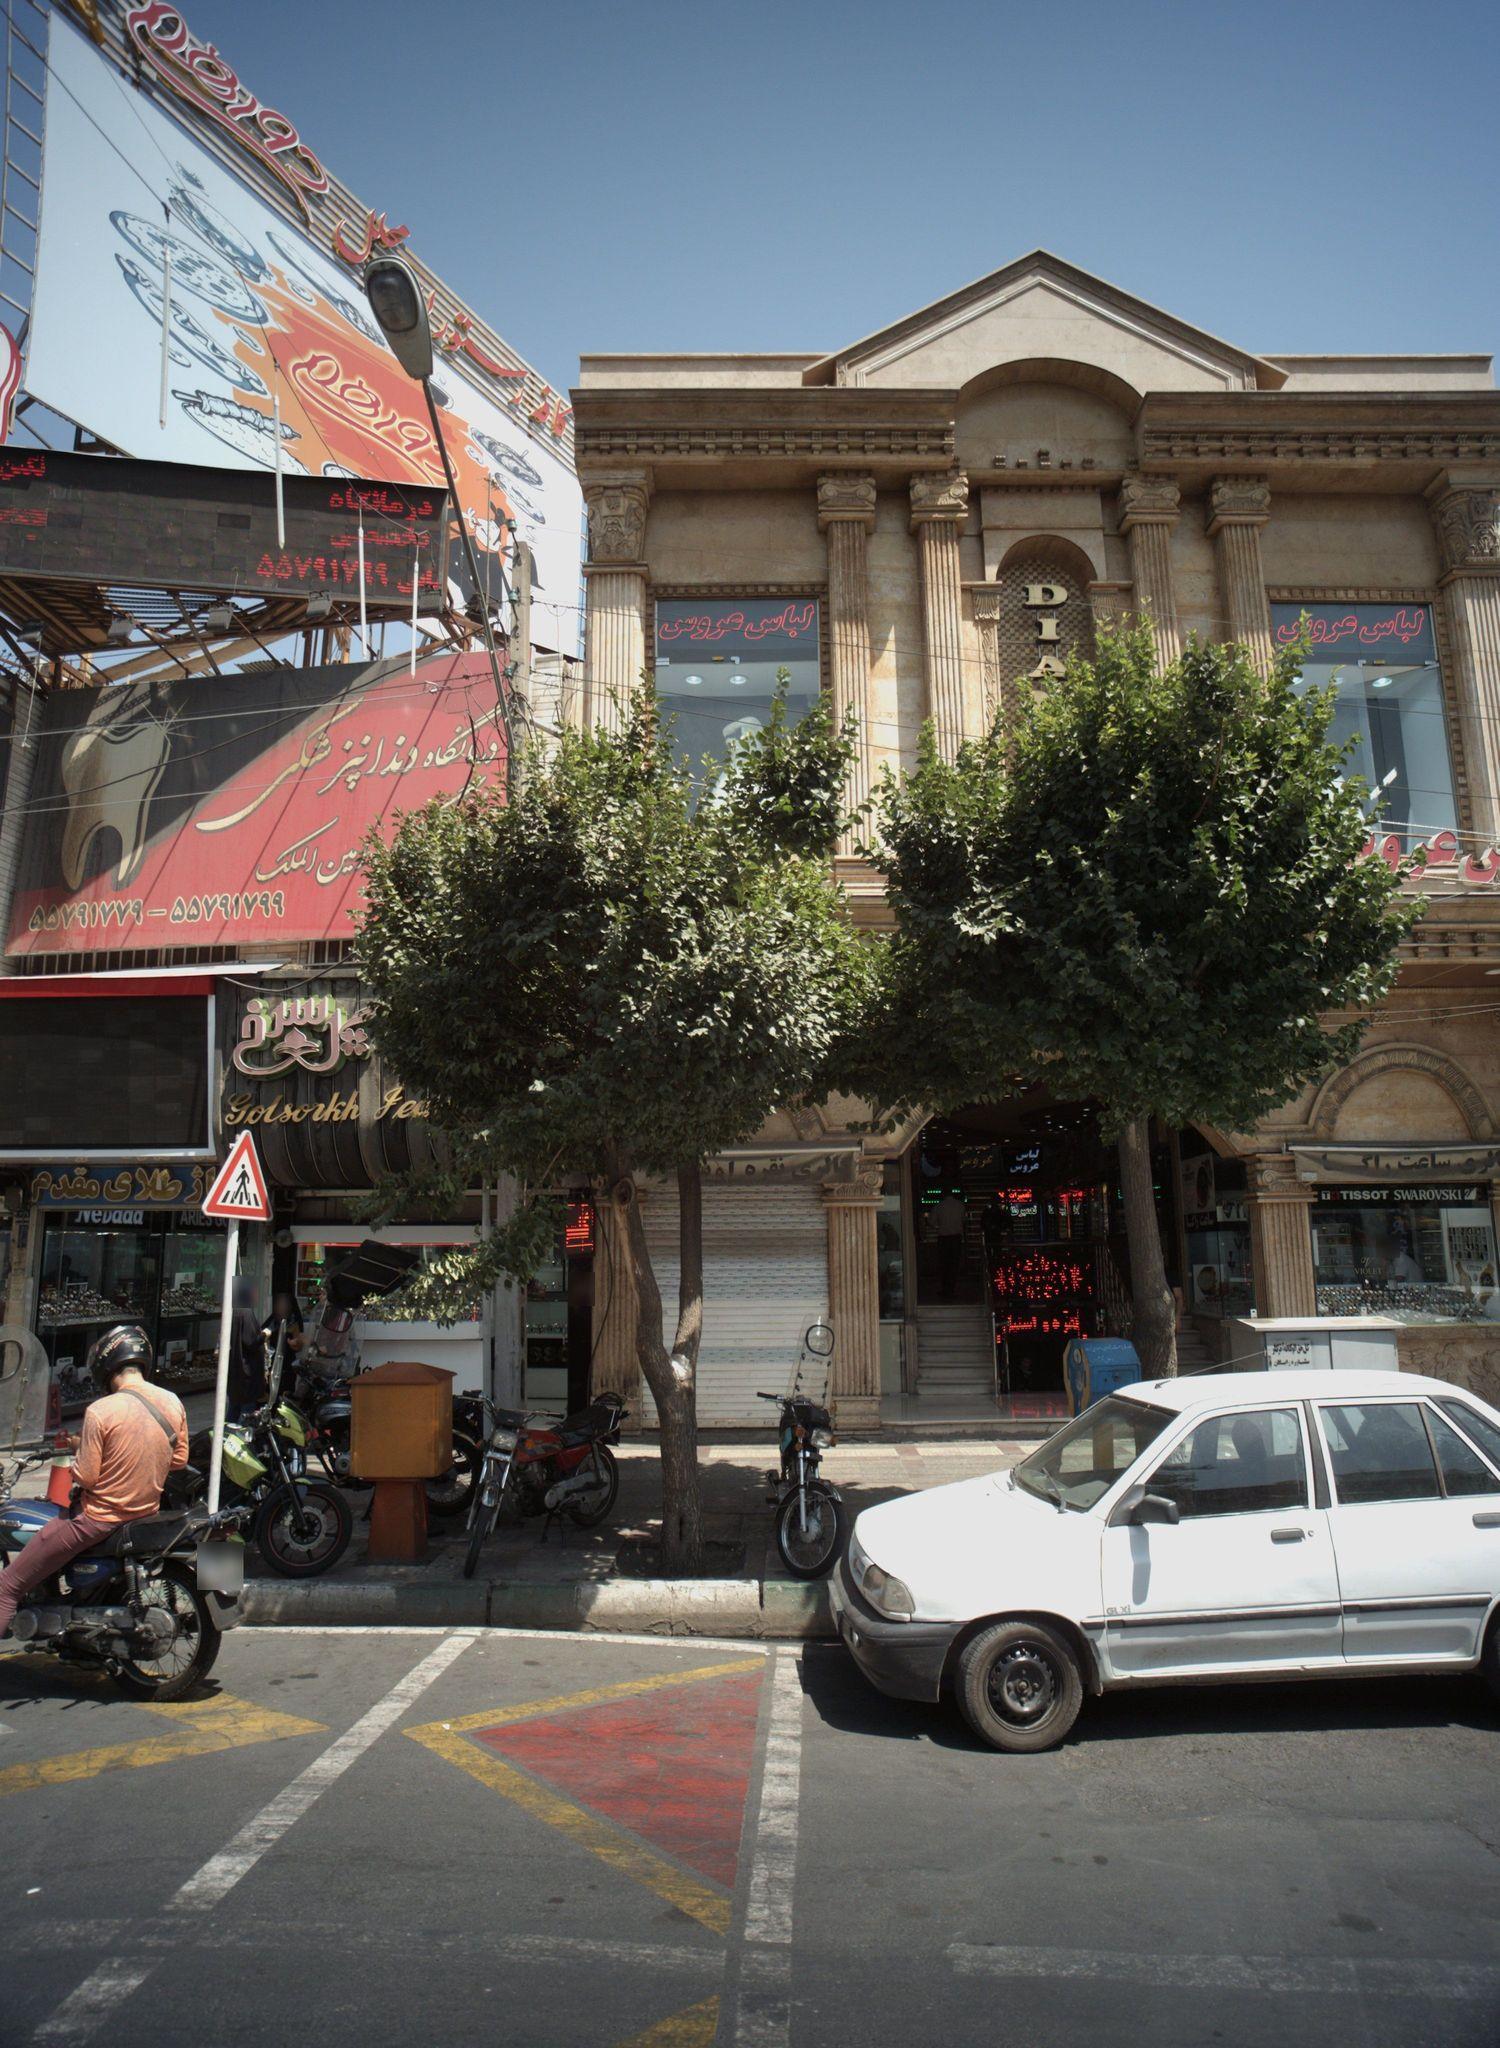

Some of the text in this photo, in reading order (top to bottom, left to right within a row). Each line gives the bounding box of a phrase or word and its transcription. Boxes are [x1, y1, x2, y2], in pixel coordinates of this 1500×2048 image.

[170, 890, 285, 923] ۵۵۷۹۱۷۹۹
[224, 1089, 361, 1126] Golsorkh
[32, 1166, 100, 1203] مقدم
[104, 1167, 183, 1202] طلای
[1340, 1190, 1390, 1200] TISSOT
[1394, 1189, 1462, 1201] SWAROVSKI
